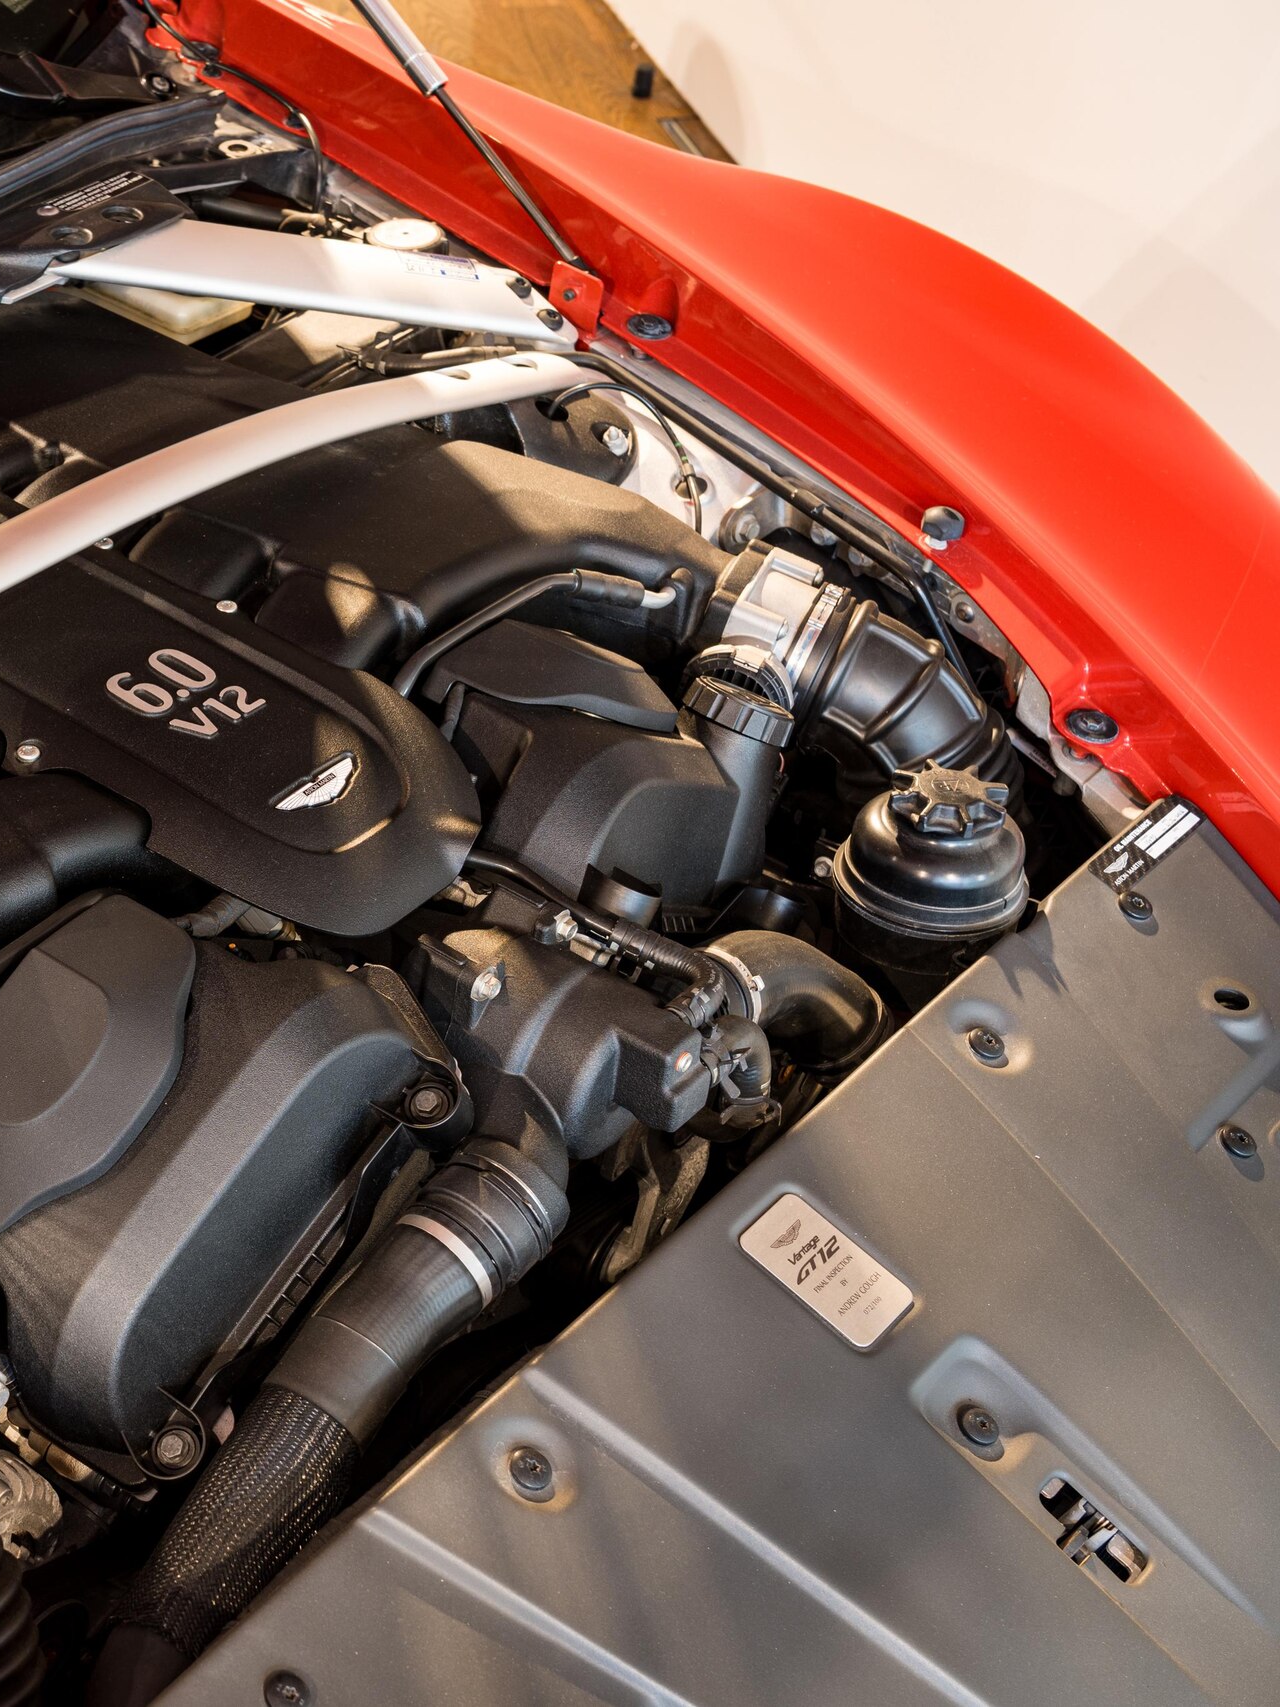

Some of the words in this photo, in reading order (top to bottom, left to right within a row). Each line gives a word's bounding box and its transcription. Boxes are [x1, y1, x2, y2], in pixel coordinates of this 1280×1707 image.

[105, 648, 217, 717] 6.0
[169, 685, 267, 739] V12
[787, 1235, 821, 1266] Vantage
[796, 1235, 840, 1286] GT12
[813, 1277, 830, 1294] FINAL
[825, 1254, 854, 1285] INSPECTION
[837, 1291, 862, 1317] ANDREW
[858, 1271, 882, 1297] GOUGH
[840, 1279, 849, 1288] BY
